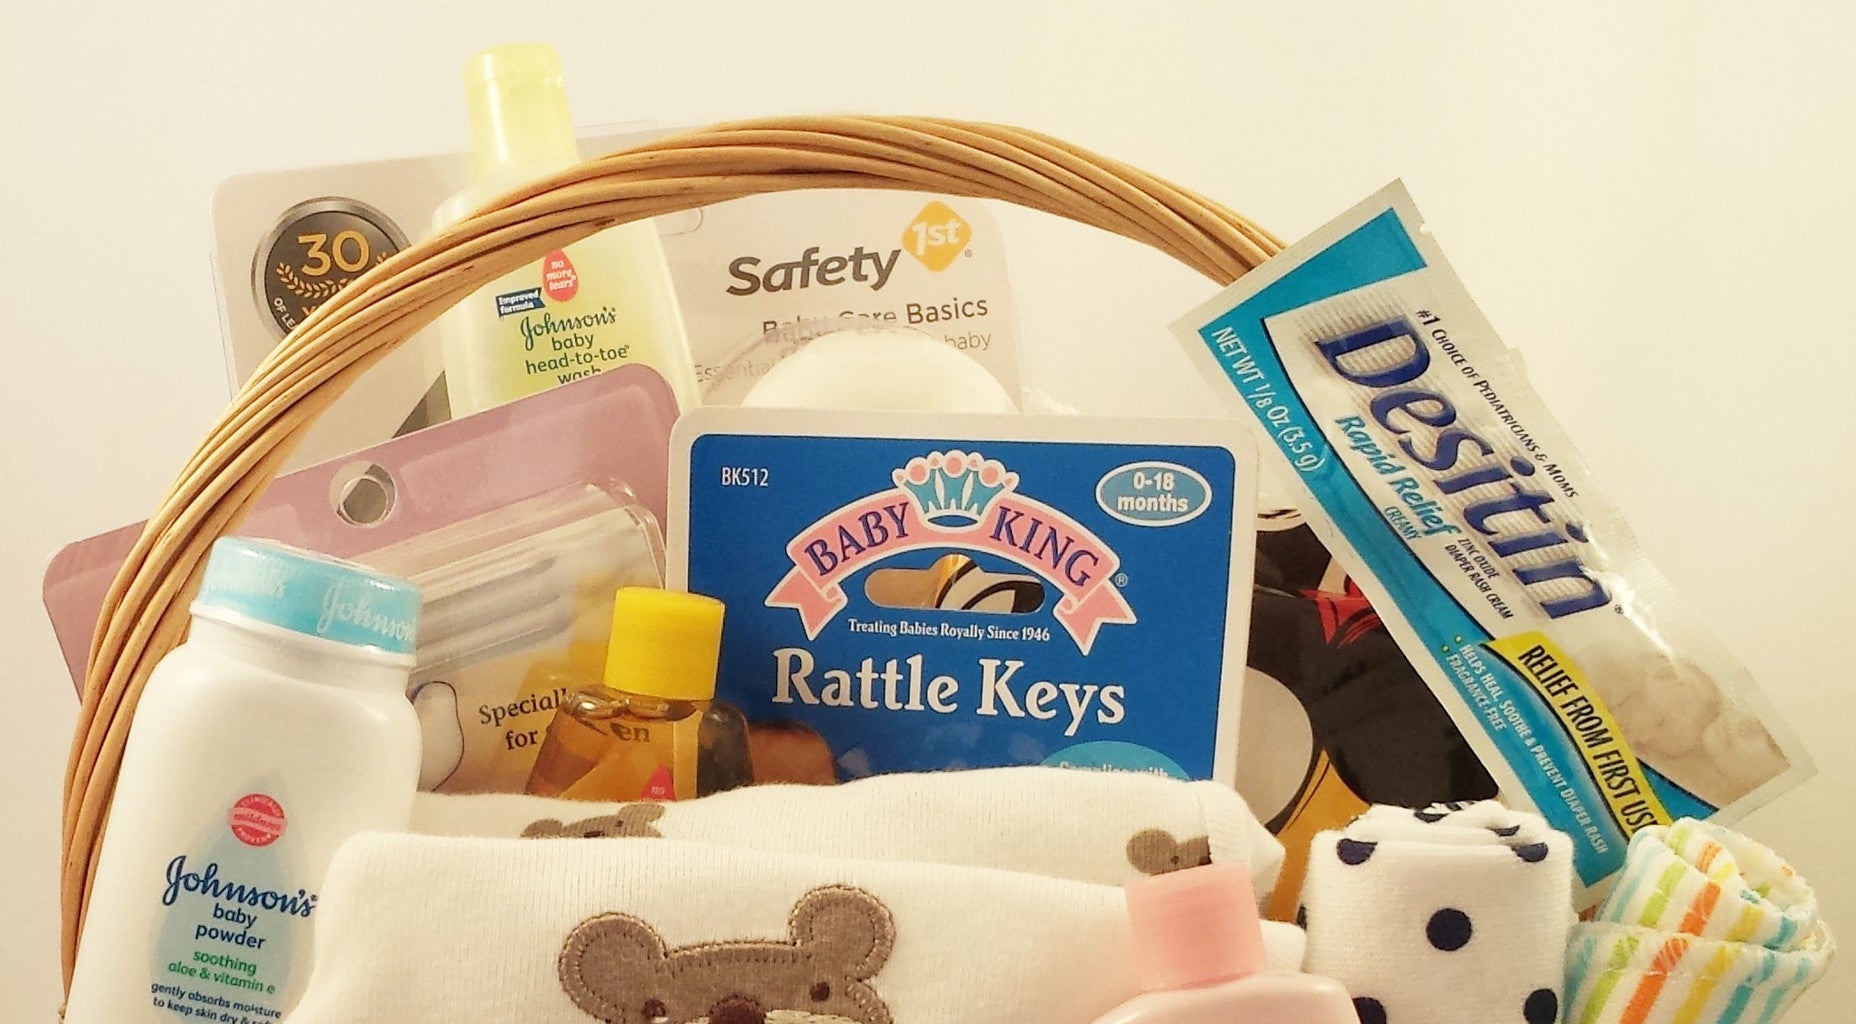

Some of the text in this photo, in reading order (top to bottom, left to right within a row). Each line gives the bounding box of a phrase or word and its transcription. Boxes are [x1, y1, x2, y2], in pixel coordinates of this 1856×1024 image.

[298, 230, 370, 277] 30
[550, 260, 565, 271] no
[726, 220, 960, 297] Safety 1st
[498, 290, 539, 306] Improved
[500, 301, 535, 314] formula
[906, 298, 989, 325] Basics
[520, 306, 617, 351] Johnson's
[552, 333, 594, 351] baby
[1211, 326, 1248, 358] NET
[525, 346, 629, 375] head-to-toe
[1231, 355, 1265, 384] WT
[1247, 383, 1276, 408] 1/8
[1416, 309, 1579, 499] #1 CHOICE OF PEDIATRICIANS & MOMS
[721, 466, 769, 487] BK512
[1133, 471, 1174, 490] 0-18
[1314, 317, 1613, 620] Desitin
[1334, 415, 1462, 536] Rapid Relief
[1117, 493, 1188, 513] months
[1384, 505, 1424, 541] CREAMY
[804, 502, 1099, 588] BABY KING
[1457, 538, 1500, 580] ZINC OXIDE
[1444, 544, 1514, 619] DIAPER RASH CREAM
[848, 618, 1050, 641] Treating Babies Royally Since 1946
[478, 688, 568, 728] Special
[772, 647, 1125, 737] Rattle Keys
[1517, 644, 1579, 699] RELIEF
[1560, 695, 1614, 749] FROM
[1592, 749, 1641, 799] FIRST
[505, 729, 539, 750] for
[1459, 644, 1487, 675] HELPS
[1499, 699, 1532, 738] SOOTHE
[1530, 744, 1568, 790] PREVENT
[1560, 788, 1592, 829] DIAPER
[1584, 825, 1609, 854] RASH
[162, 855, 316, 918] Johnson's
[213, 903, 257, 929] baby
[195, 924, 266, 949] powder
[168, 961, 276, 994] aloe & vitamin e
[193, 950, 258, 976] soothing
[151, 982, 282, 1019] gently absorbs moisture
[153, 997, 165, 1008] to
[167, 1000, 193, 1016] keep
[195, 1006, 217, 1020] skin
